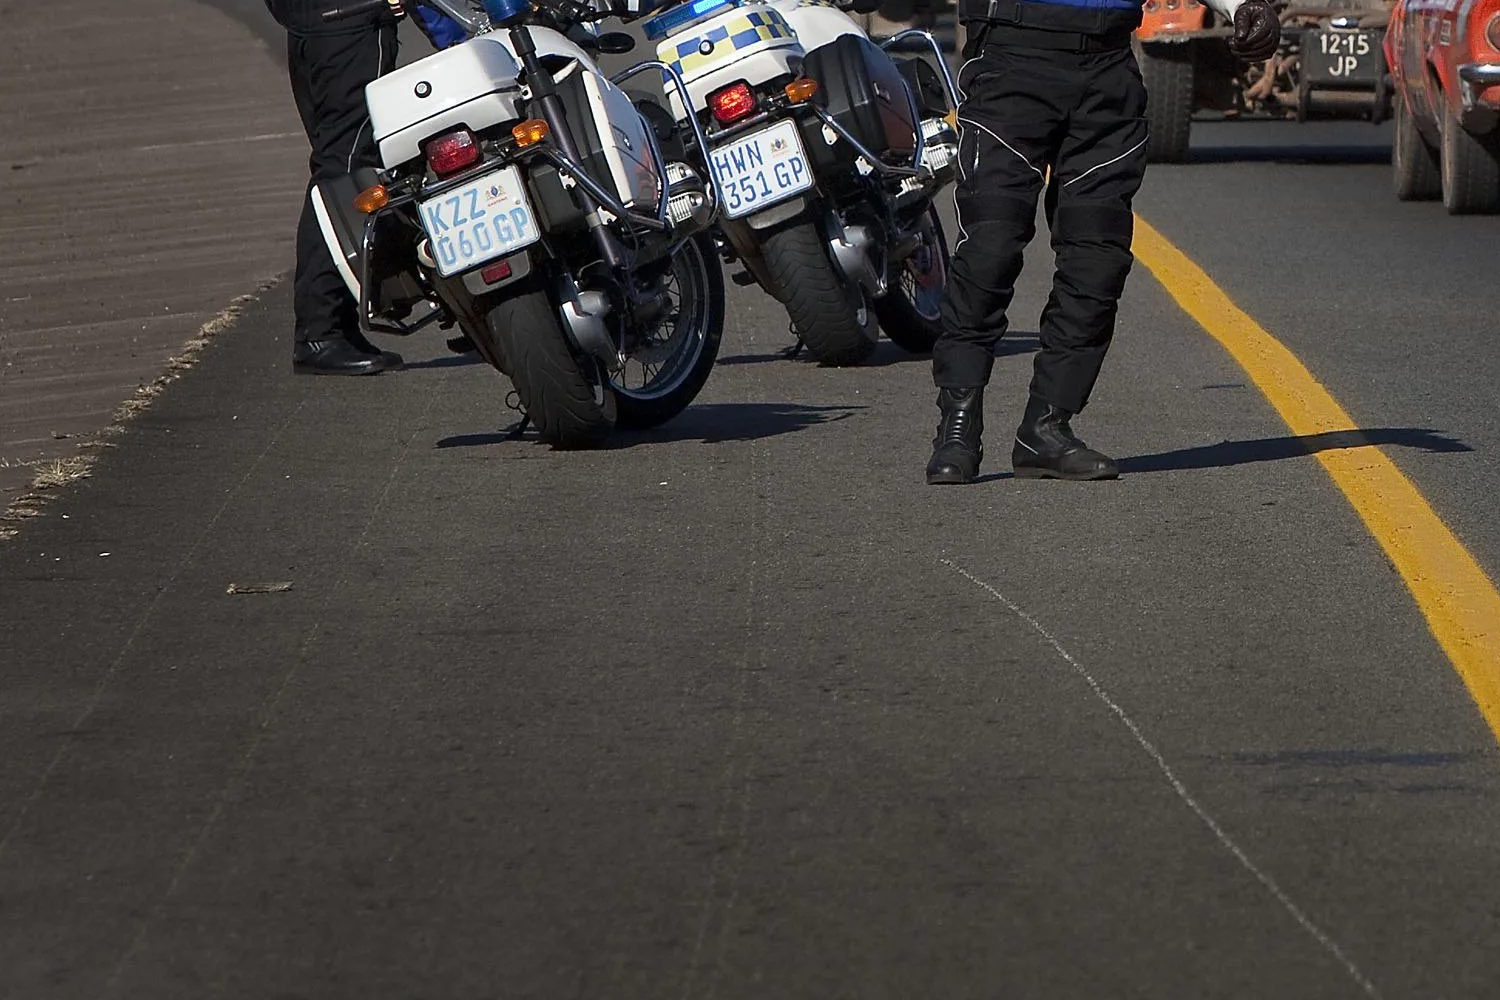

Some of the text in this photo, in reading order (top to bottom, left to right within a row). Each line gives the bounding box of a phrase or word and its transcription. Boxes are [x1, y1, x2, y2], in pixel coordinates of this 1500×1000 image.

[1328, 55, 1358, 77] JP
[714, 140, 763, 181] HWN
[725, 157, 803, 209] 351 GP
[427, 188, 486, 234] KZZ
